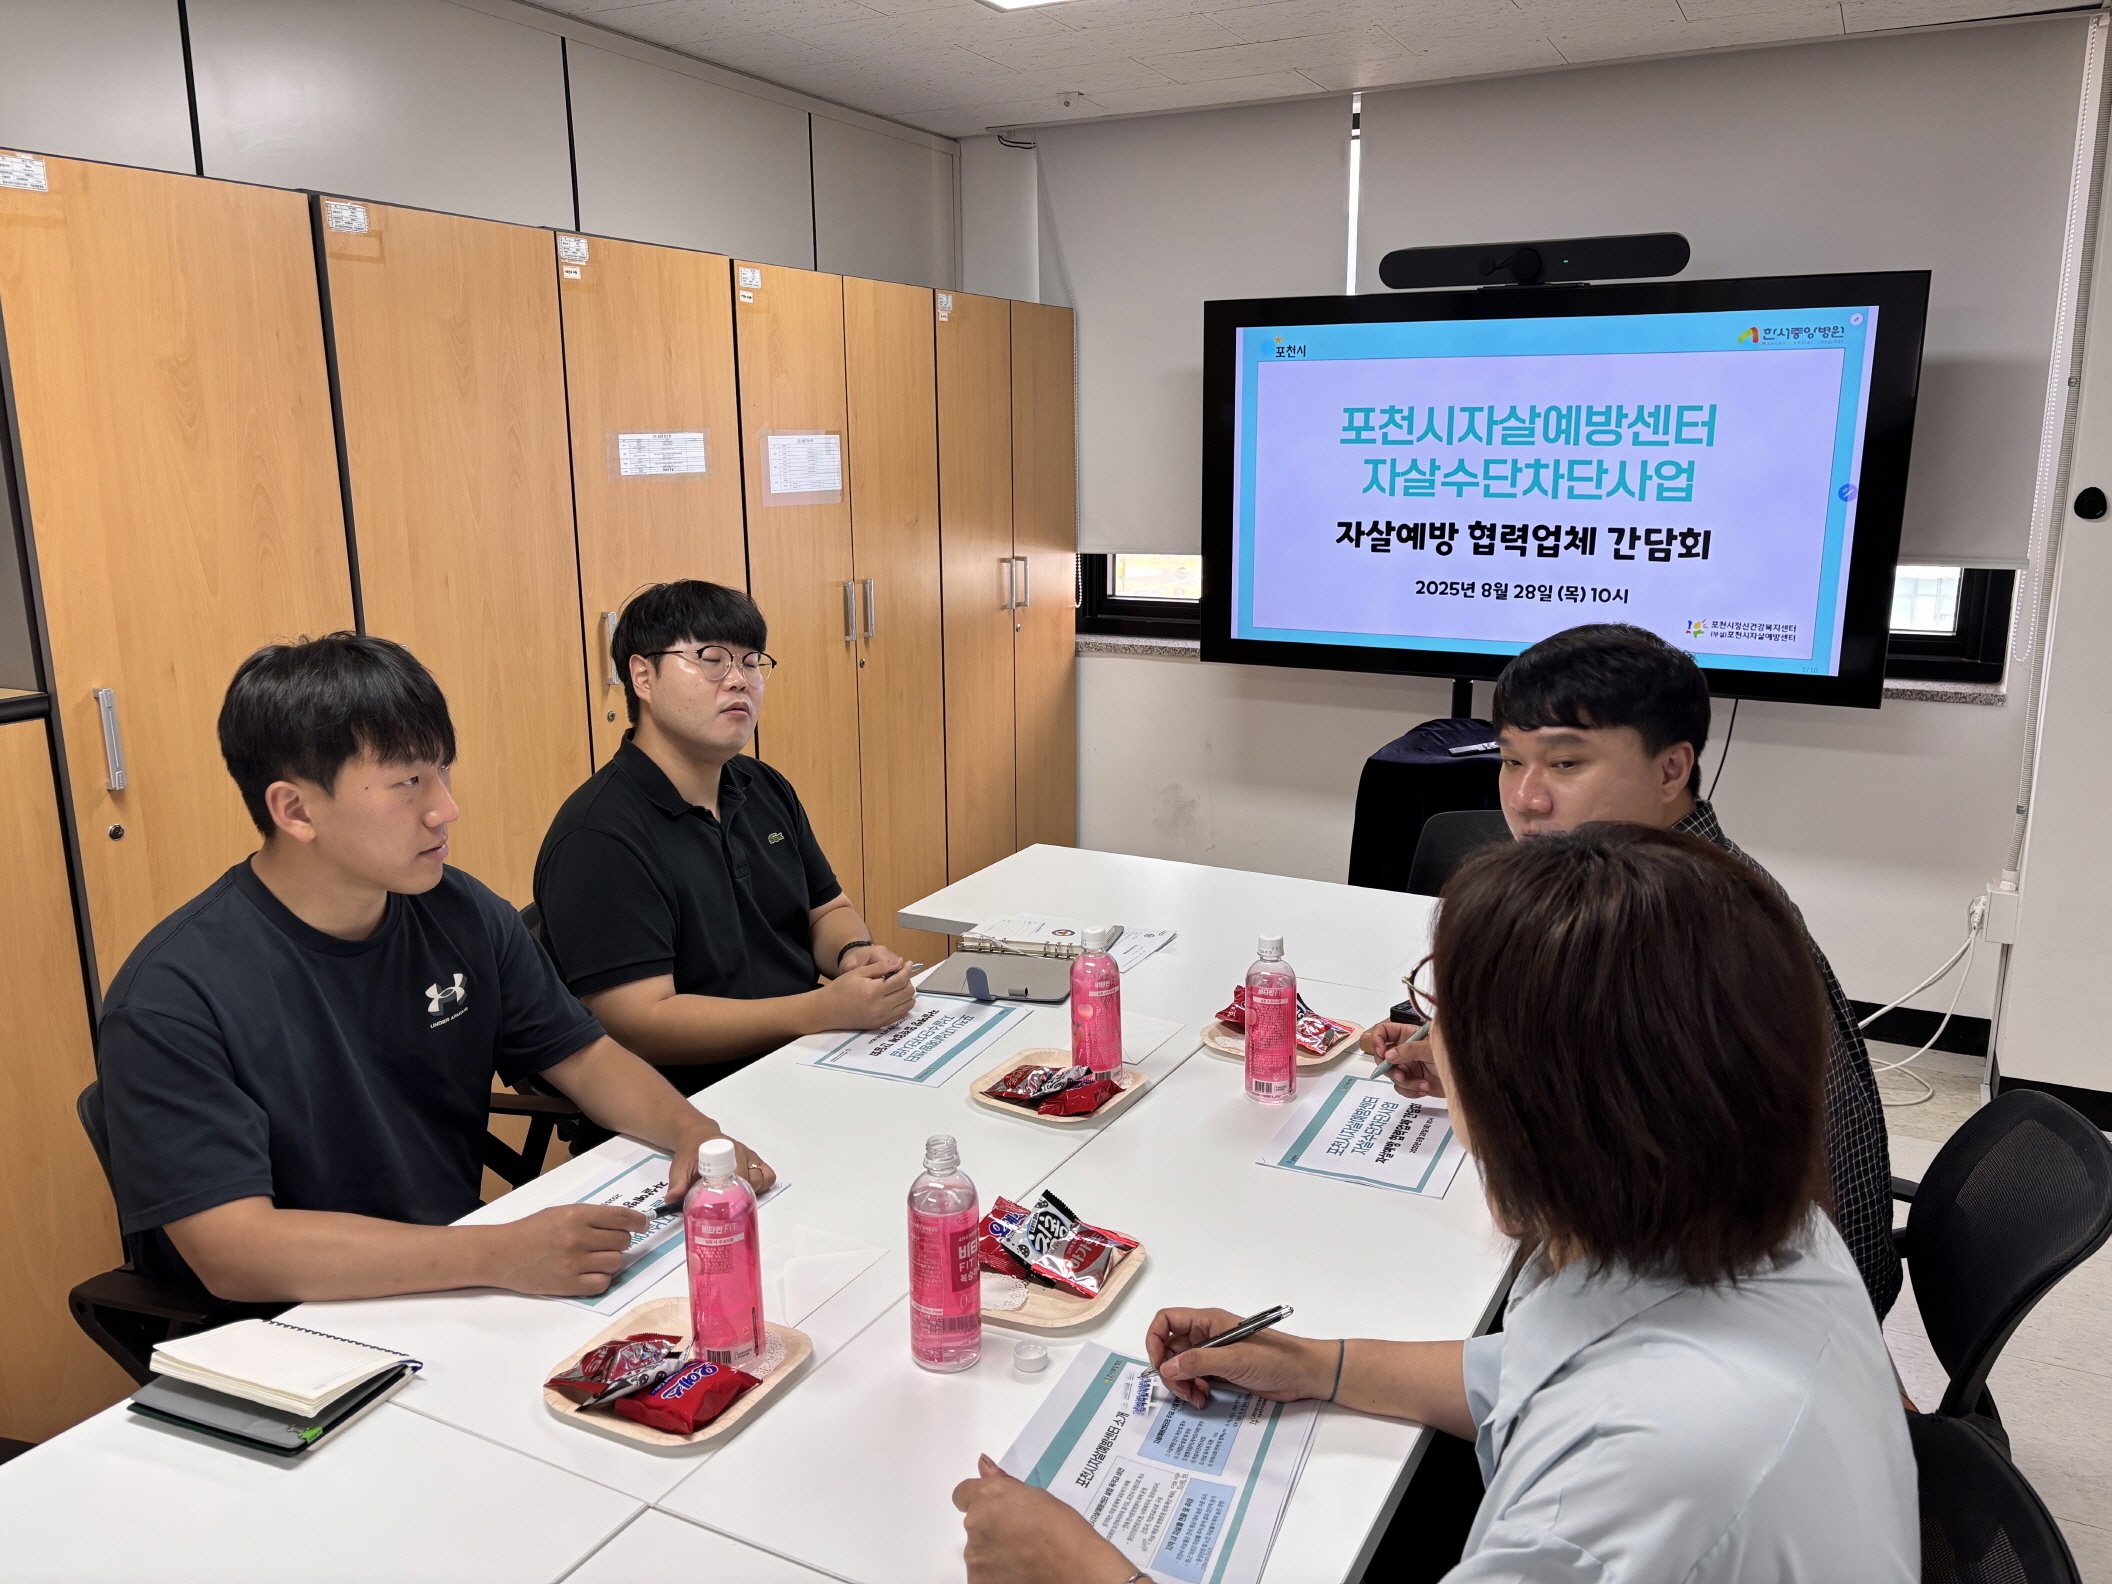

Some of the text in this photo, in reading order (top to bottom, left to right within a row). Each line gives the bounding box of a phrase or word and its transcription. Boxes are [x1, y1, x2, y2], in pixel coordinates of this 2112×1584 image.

[1276, 345, 1306, 358] 포천시
[1339, 403, 1718, 447] 포천시자살예방센터
[1362, 457, 1696, 502] 자살수단차단사업
[1335, 520, 1712, 562] 자살예방 협력업체 간담회
[1415, 580, 1629, 604] 2025년 8월 28일 (목) 10시
[1711, 620, 1797, 633] 포천시정신건강복지센터
[1802, 666, 1818, 674] 1/10
[430, 1017, 450, 1029] UNDER
[1326, 1096, 1380, 1157] 포천시자살예방센터
[1351, 1101, 1400, 1156] 자살수단차단사업
[1375, 1137, 1402, 1165] 자살예방
[1402, 1102, 1422, 1122] 간담회
[702, 1222, 737, 1235] 비타민 FIT
[958, 1238, 978, 1260] 비타
[959, 1257, 975, 1272] FIT
[660, 1361, 719, 1400] 오예스
[1075, 1425, 1121, 1488] 포천시자살예방센터
[1113, 1411, 1130, 1427] 소개
[1088, 1495, 1110, 1526] 시자살예방센터
